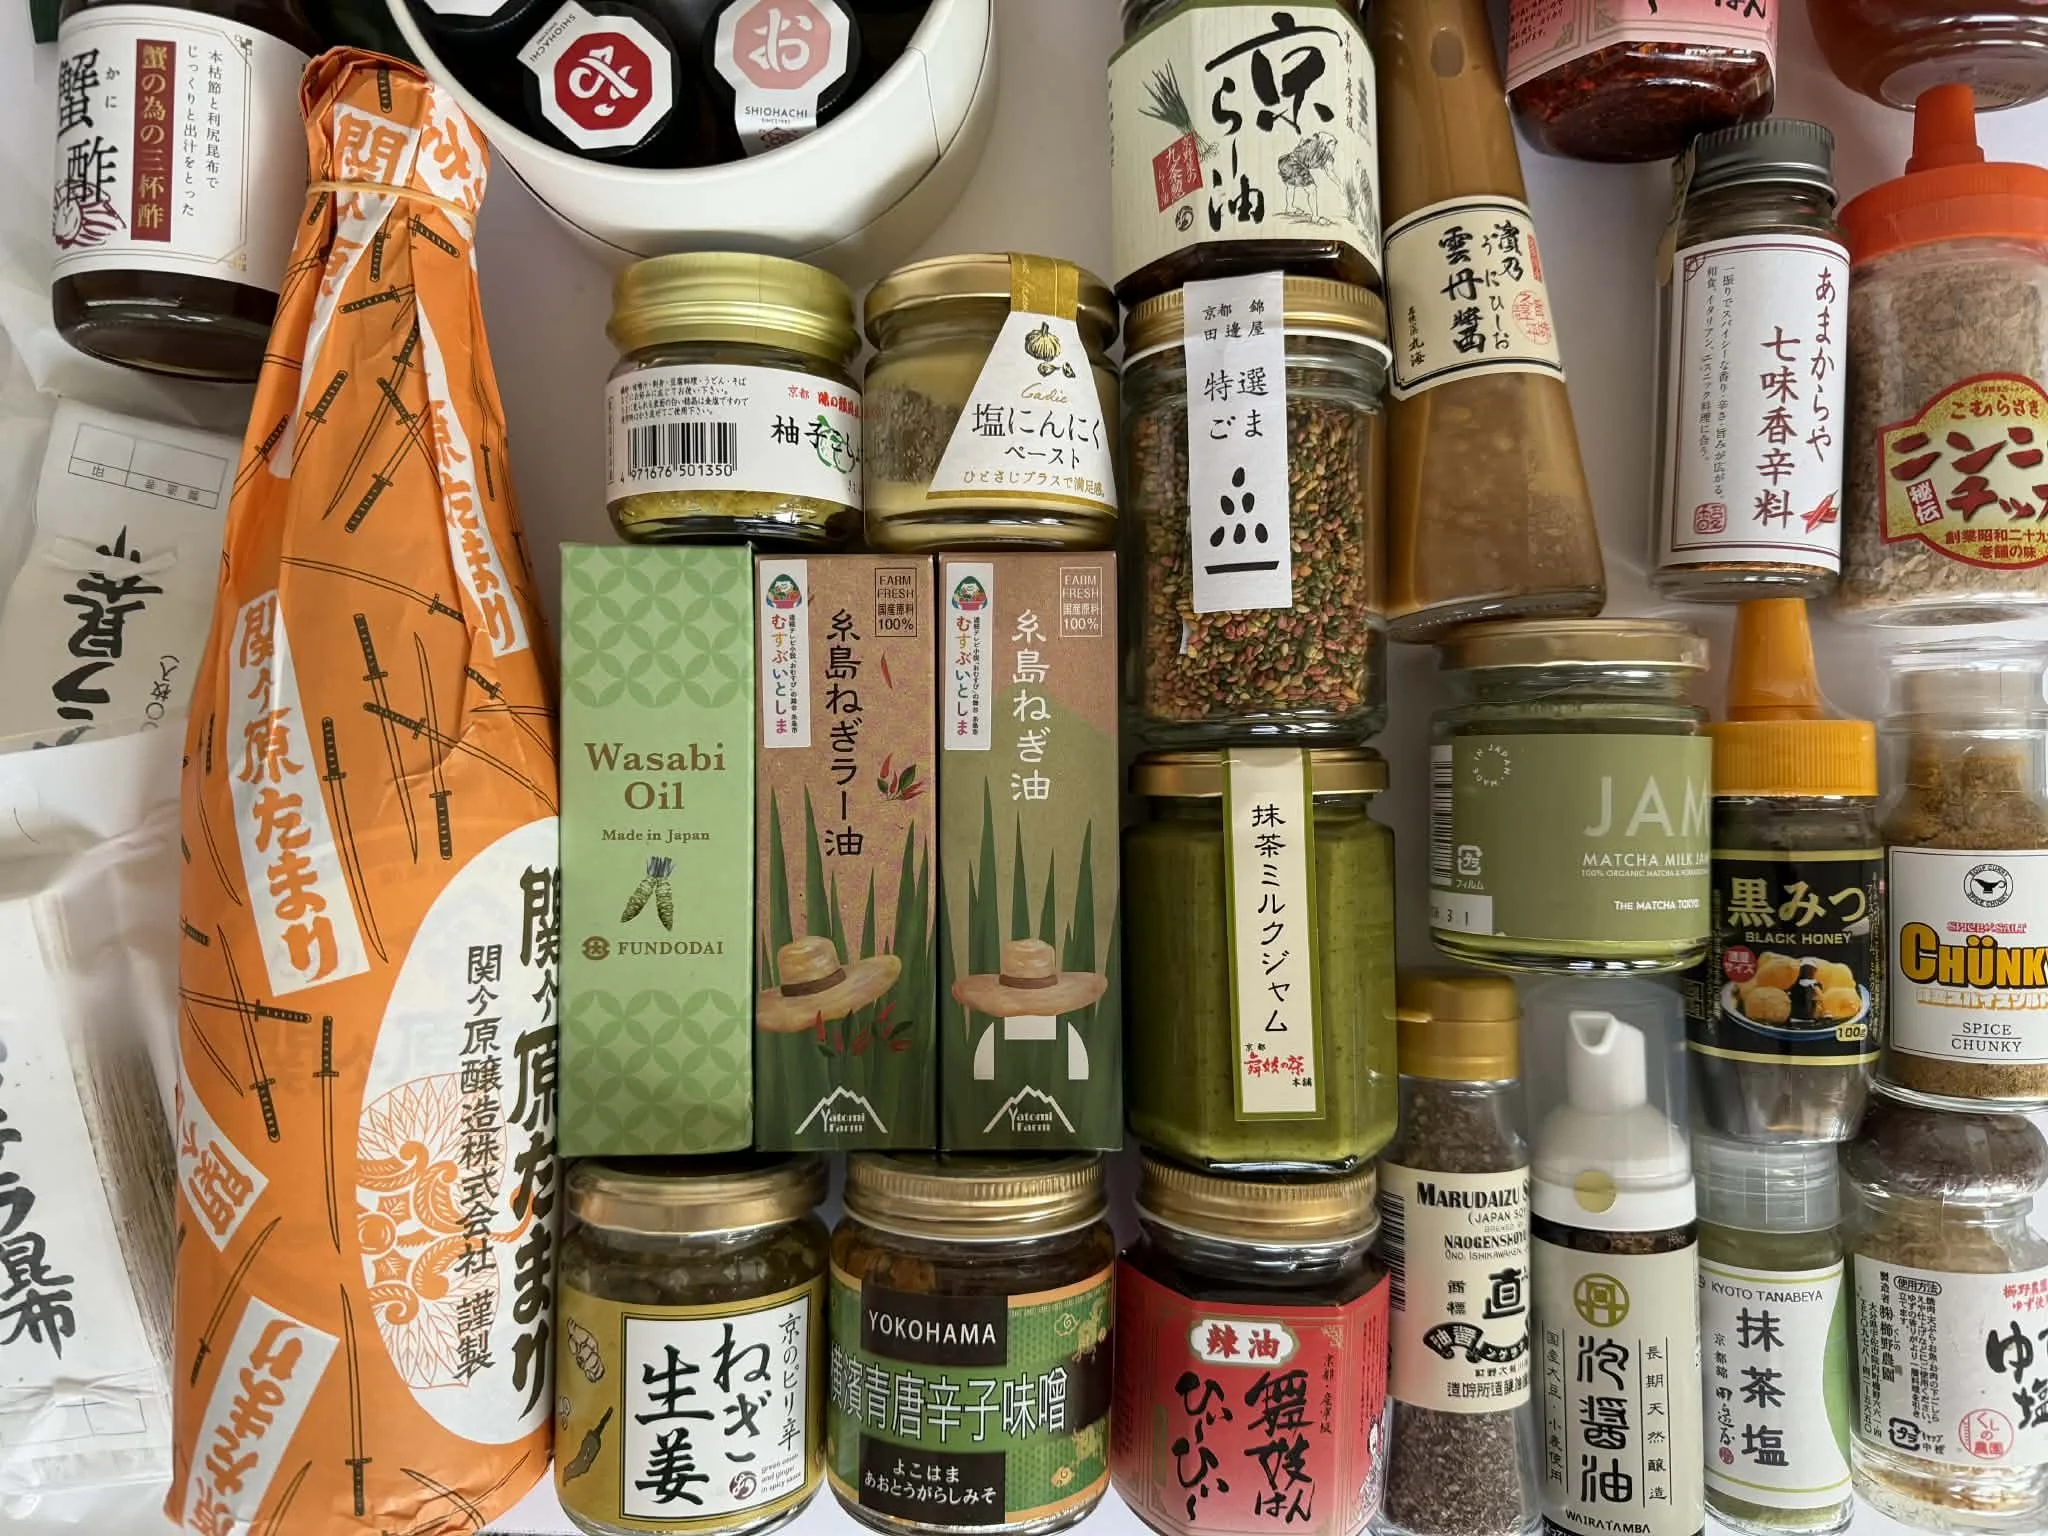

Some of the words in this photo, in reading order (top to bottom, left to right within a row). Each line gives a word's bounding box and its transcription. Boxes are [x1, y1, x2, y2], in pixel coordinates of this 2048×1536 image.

[529, 13, 578, 64] SHIOHACHI
[104, 65, 121, 110] かに
[744, 104, 808, 119] SHIOHACHI
[1202, 303, 1232, 322] 京都
[1248, 297, 1265, 314] 錦
[1806, 266, 1836, 463] あまからや
[1203, 366, 1270, 402] 特選
[971, 402, 1100, 450] 塩にんにく
[1209, 408, 1264, 441] ごま
[1751, 325, 1802, 529] 七味香辛料
[1004, 446, 1080, 470] ペースト
[1890, 426, 2048, 481] ニンニ
[631, 466, 673, 481] 971676
[680, 463, 733, 477] 501350
[1945, 528, 2048, 545] 創業昭和二十九
[877, 588, 915, 599] FRESH
[879, 575, 912, 586] FARM
[1062, 588, 1099, 599] FRESH
[878, 618, 915, 631] 100%
[1063, 618, 1099, 631] 100%
[770, 613, 790, 735] むすぶいとしま
[955, 615, 972, 736] むすぶいとしま
[1011, 608, 1051, 801] 糸島ねぎ油
[824, 607, 864, 858] 糸島ねぎラー油
[585, 742, 727, 772] Wasabi
[624, 781, 685, 811] Oil
[602, 829, 643, 842] Made
[647, 829, 662, 842] in
[666, 829, 711, 844] Japan
[1582, 868, 1605, 878] 100%
[1605, 868, 1645, 878] ORGANIC
[1583, 852, 1659, 867] MATCHA
[1664, 852, 1692, 867] MILK
[1456, 879, 1485, 890] フィルム
[1614, 900, 1633, 911] THE
[1635, 900, 1676, 911] MATCHA
[1727, 876, 1868, 929] 黒みつ
[1251, 803, 1292, 1034] 抹茶ミルクジャム
[618, 940, 724, 956] FUNDODAI
[1745, 931, 1797, 945] BLACK
[1802, 932, 1852, 945] HONEY
[1962, 1021, 2012, 1036] SPICE
[1951, 1038, 2023, 1053] CHUNKY
[820, 1107, 865, 1133] Yatomi
[828, 1124, 864, 1133] Farm
[1007, 1106, 1053, 1132] Yatomi
[1016, 1122, 1051, 1132] Farm
[1416, 1181, 1520, 1209] MARUDAIZU
[1482, 1266, 1526, 1321] 直
[1711, 1280, 1753, 1300] KYOTO
[1758, 1289, 1823, 1303] TANABEYA
[1898, 1277, 1940, 1295] 使用方法
[453, 1288, 496, 1381] 謹製
[868, 1309, 997, 1345] YOKOHAMA
[1206, 1323, 1281, 1360] 辣油
[1985, 1320, 2048, 1385] ゆ
[777, 1312, 802, 1452] 京のピリ辛
[1735, 1307, 1790, 1467] 抹茶塩
[634, 1343, 715, 1506] 生姜
[1645, 1344, 1667, 1501] 長期天然醸造
[893, 1458, 960, 1484] よこはま
[864, 1469, 997, 1506] あおとうがらしみそ
